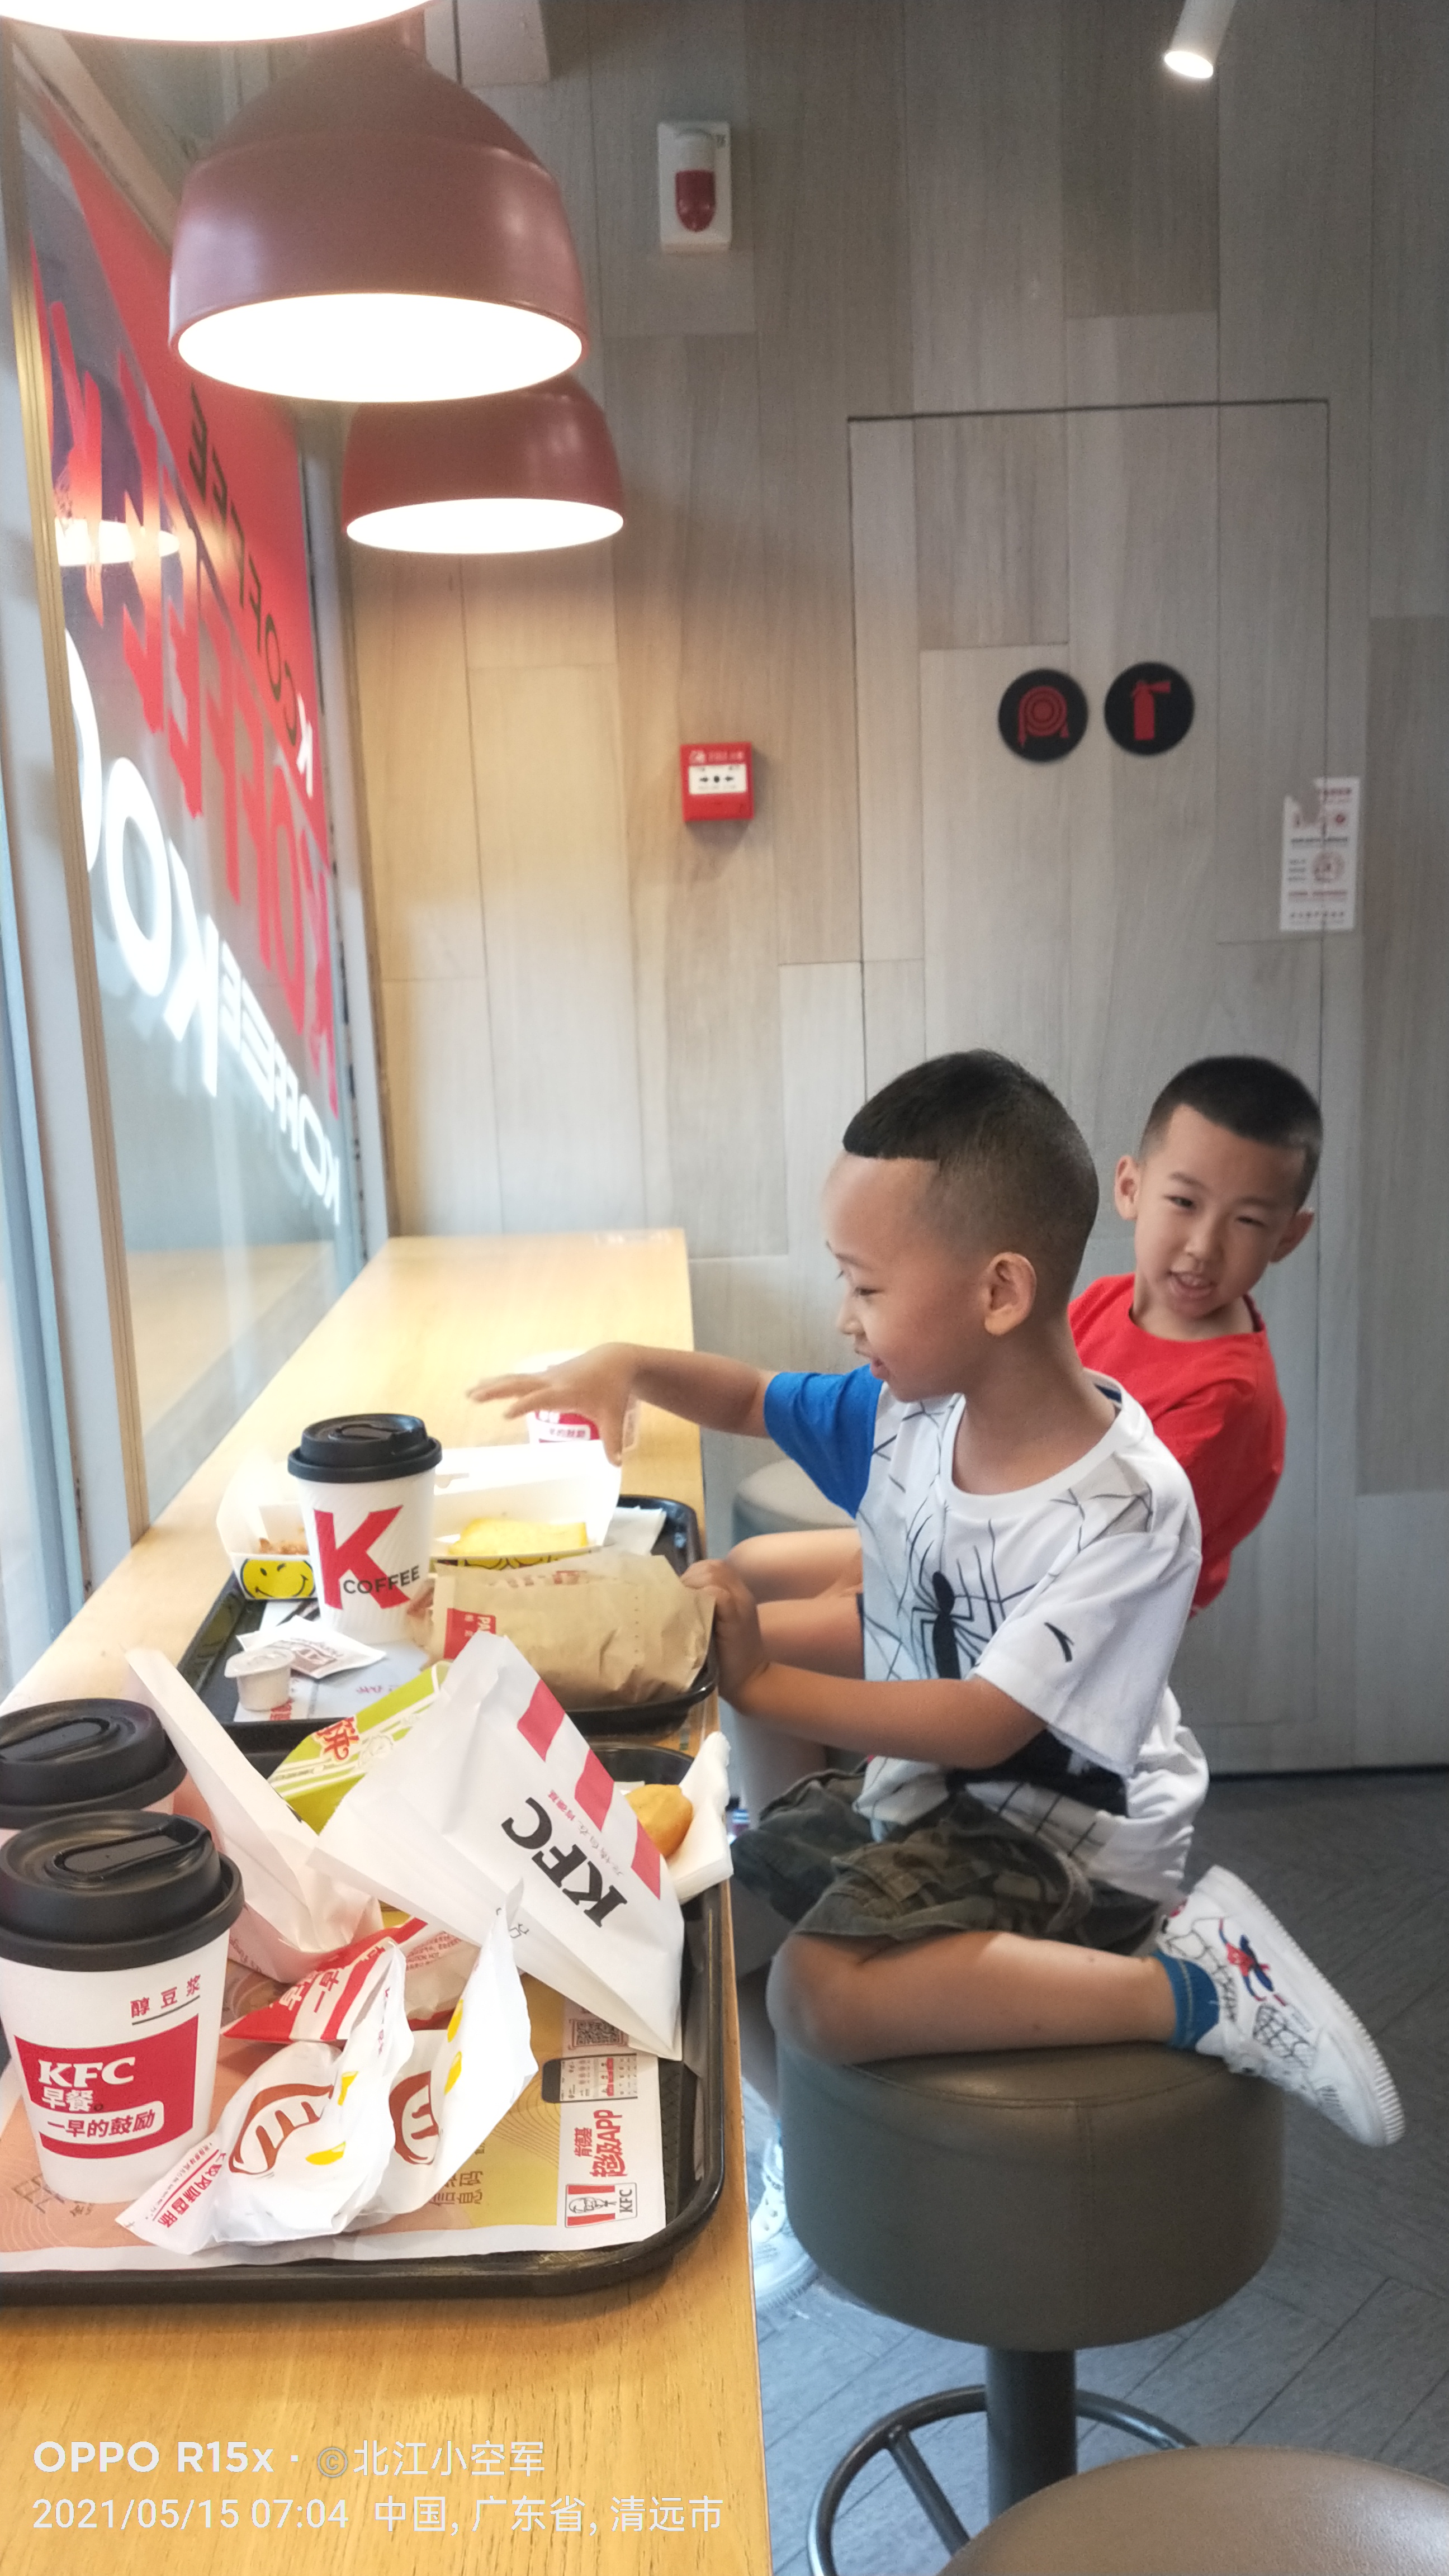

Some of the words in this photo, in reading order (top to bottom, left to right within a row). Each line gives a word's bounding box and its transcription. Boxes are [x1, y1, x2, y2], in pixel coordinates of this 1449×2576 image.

[314, 1504, 411, 1609] K
[343, 1565, 420, 1594] COFFEE
[501, 1797, 628, 1928] KFC
[130, 1974, 201, 2018] 醇豆浆
[37, 2056, 136, 2088] KFC
[41, 2086, 94, 2112] 早餐
[47, 2109, 156, 2138] 一早的鼓励
[619, 2189, 633, 2213] KFC
